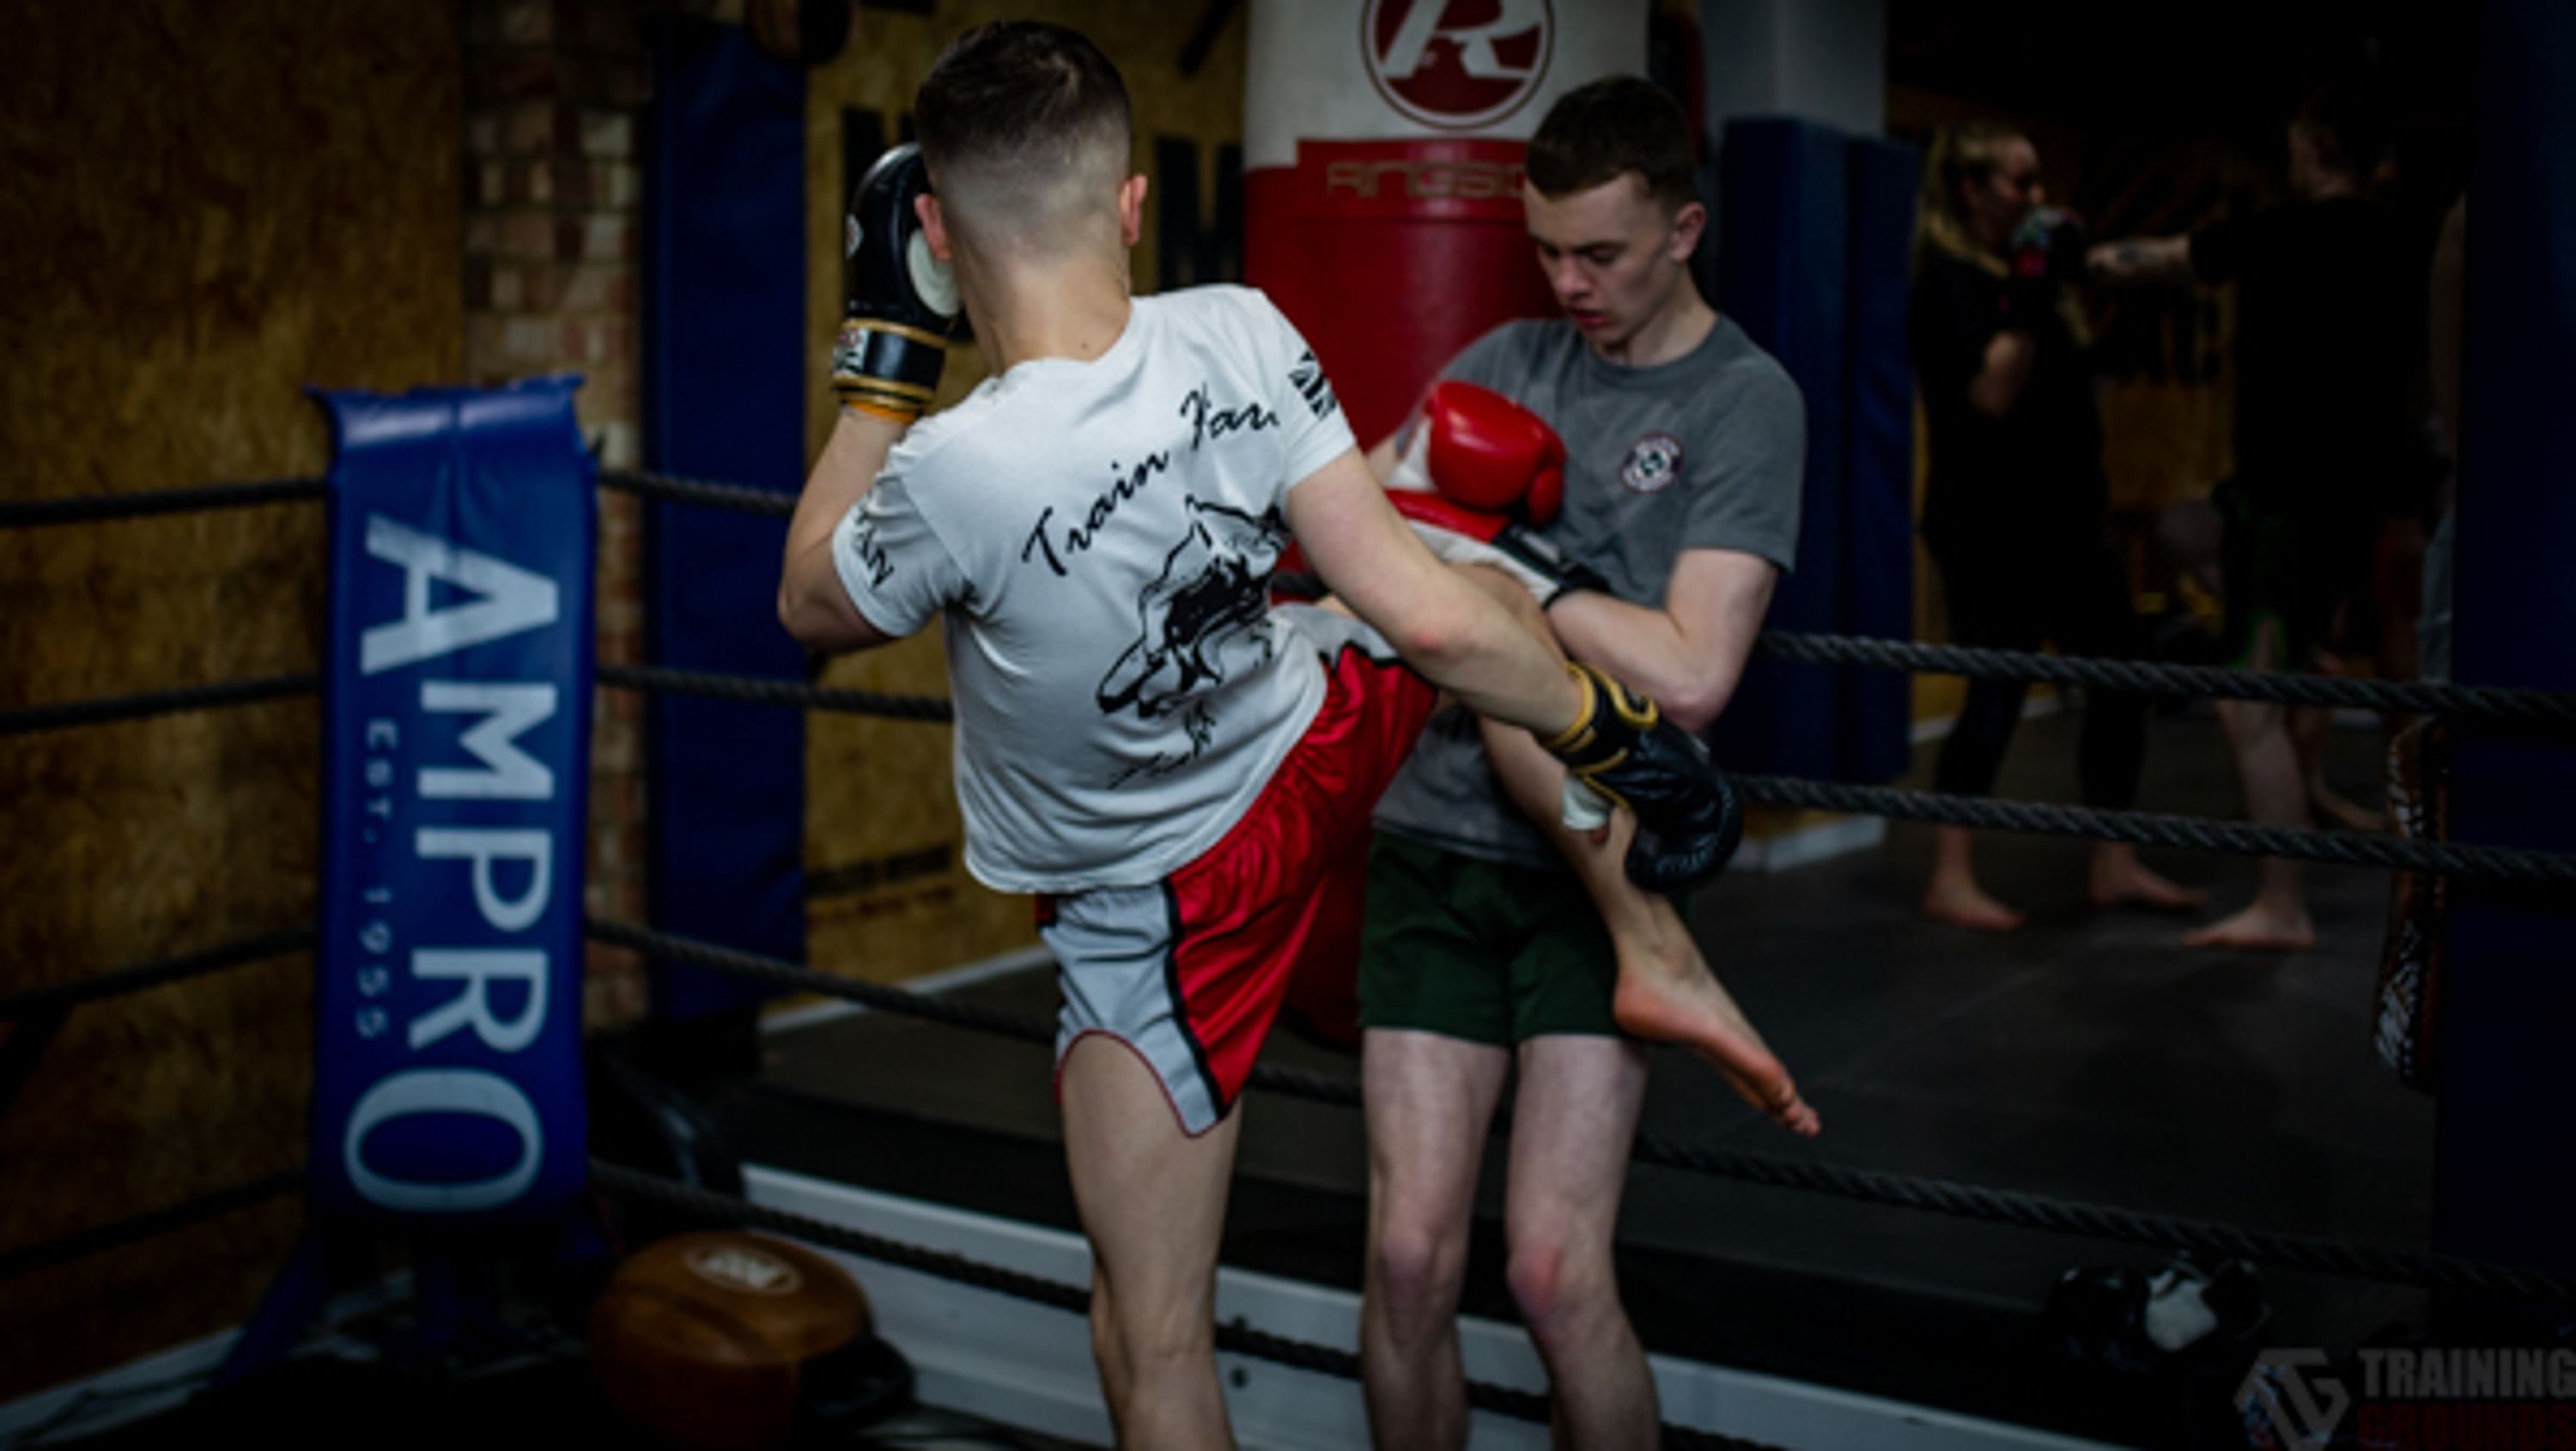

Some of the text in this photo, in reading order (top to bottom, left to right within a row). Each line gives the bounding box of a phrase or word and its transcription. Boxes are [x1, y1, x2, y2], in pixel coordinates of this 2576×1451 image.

[1326, 158, 1525, 200] RINGSI
[1022, 451, 1170, 577] Train
[345, 513, 560, 1211] AMPRO
[355, 719, 399, 1040] EST. 1955
